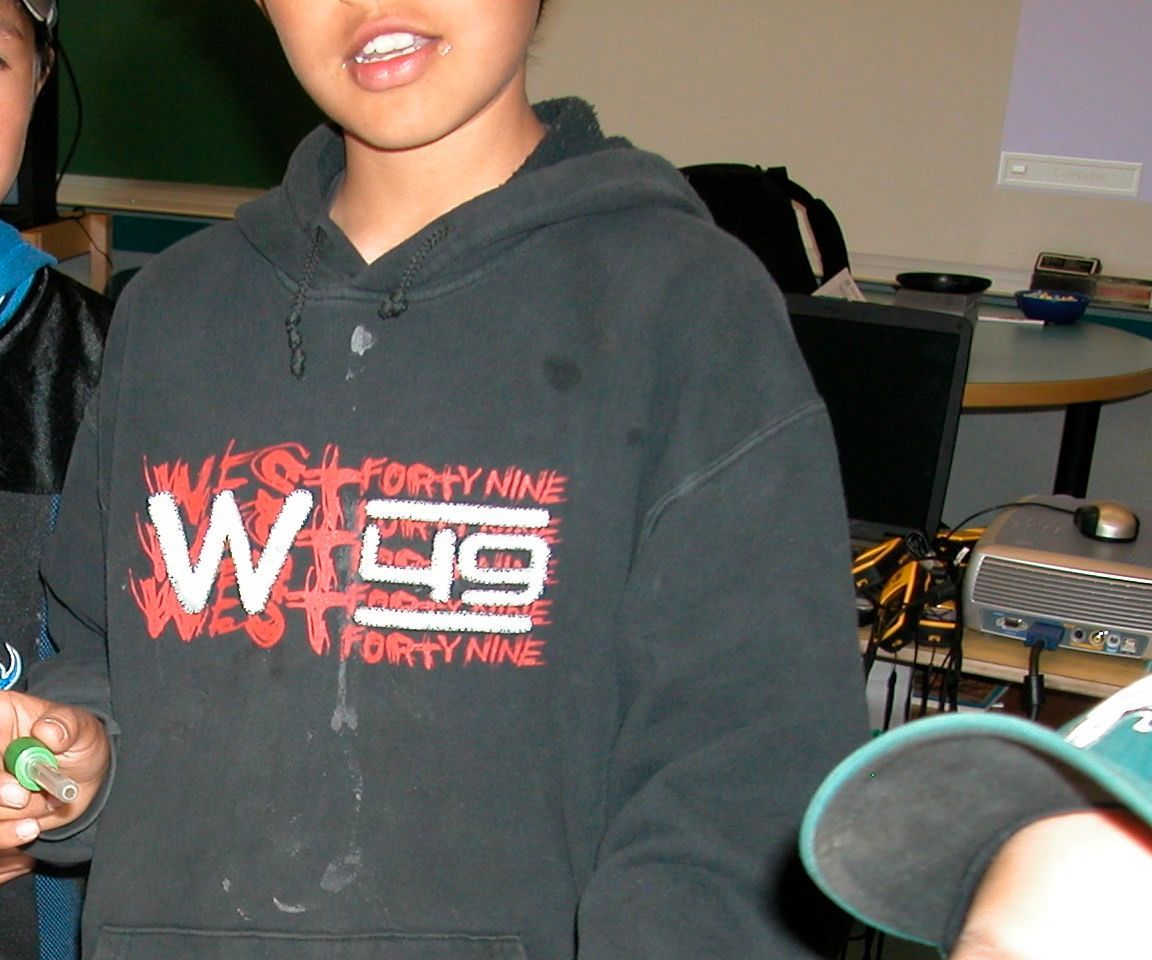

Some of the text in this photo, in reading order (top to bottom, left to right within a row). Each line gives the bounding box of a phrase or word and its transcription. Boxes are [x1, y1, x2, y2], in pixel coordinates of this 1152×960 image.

[359, 457, 569, 504] FORTY NINE
[341, 625, 547, 670] FORTY NINE
